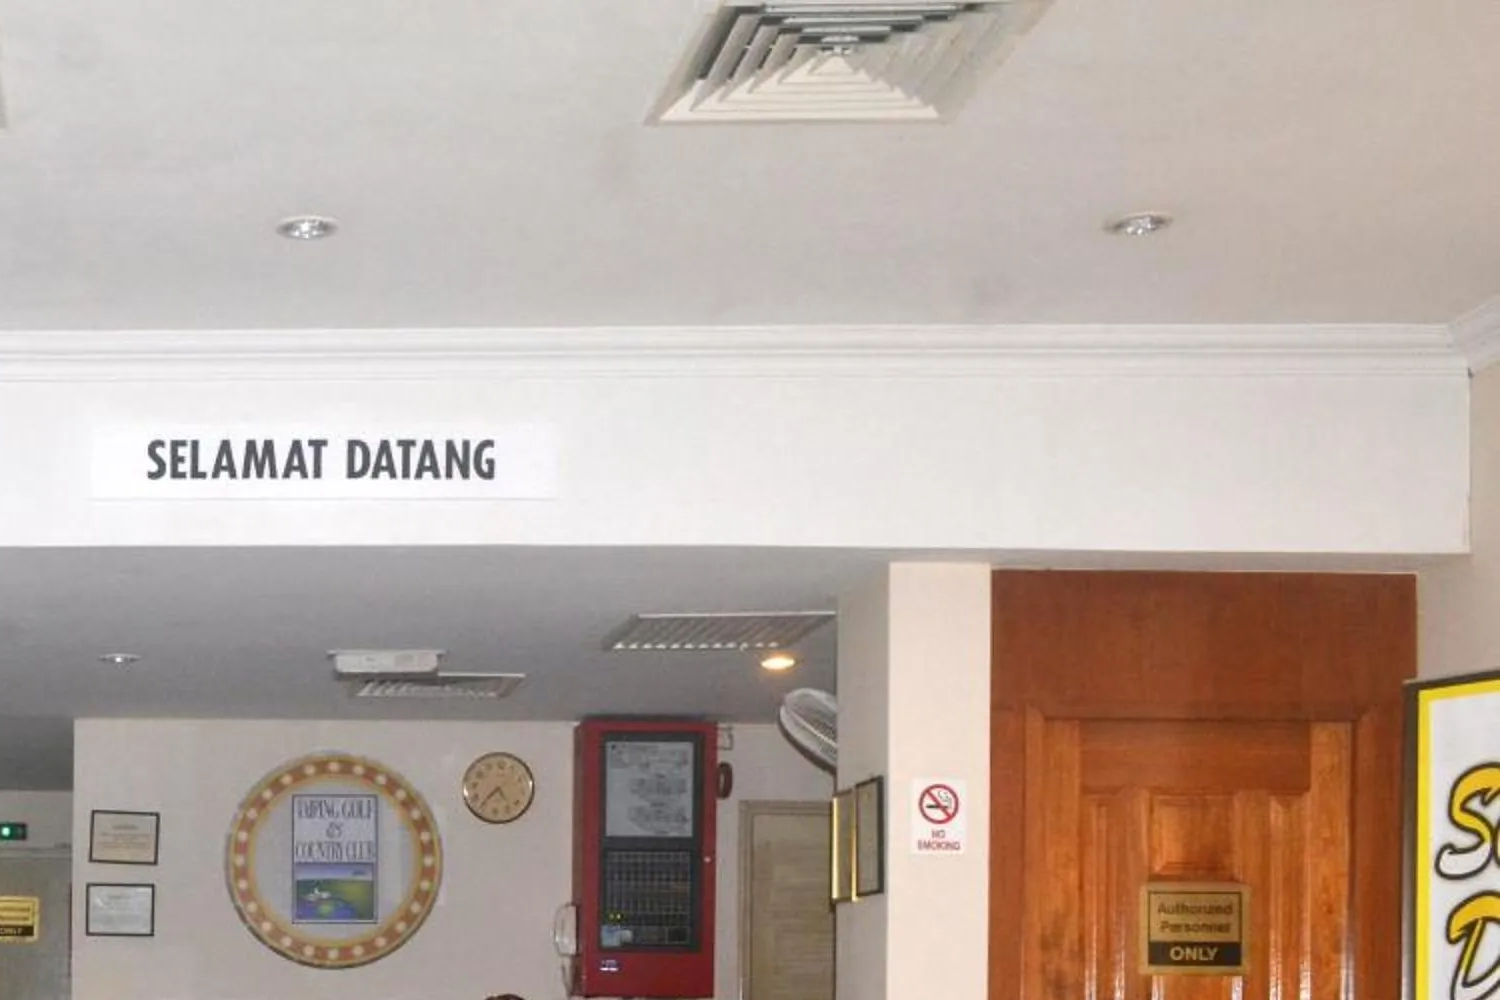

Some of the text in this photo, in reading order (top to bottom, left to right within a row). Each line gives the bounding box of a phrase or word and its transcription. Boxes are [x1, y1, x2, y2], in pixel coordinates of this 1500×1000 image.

[147, 439, 495, 480] SELAMAT DATANG
[1169, 946, 1218, 961] ONLY
